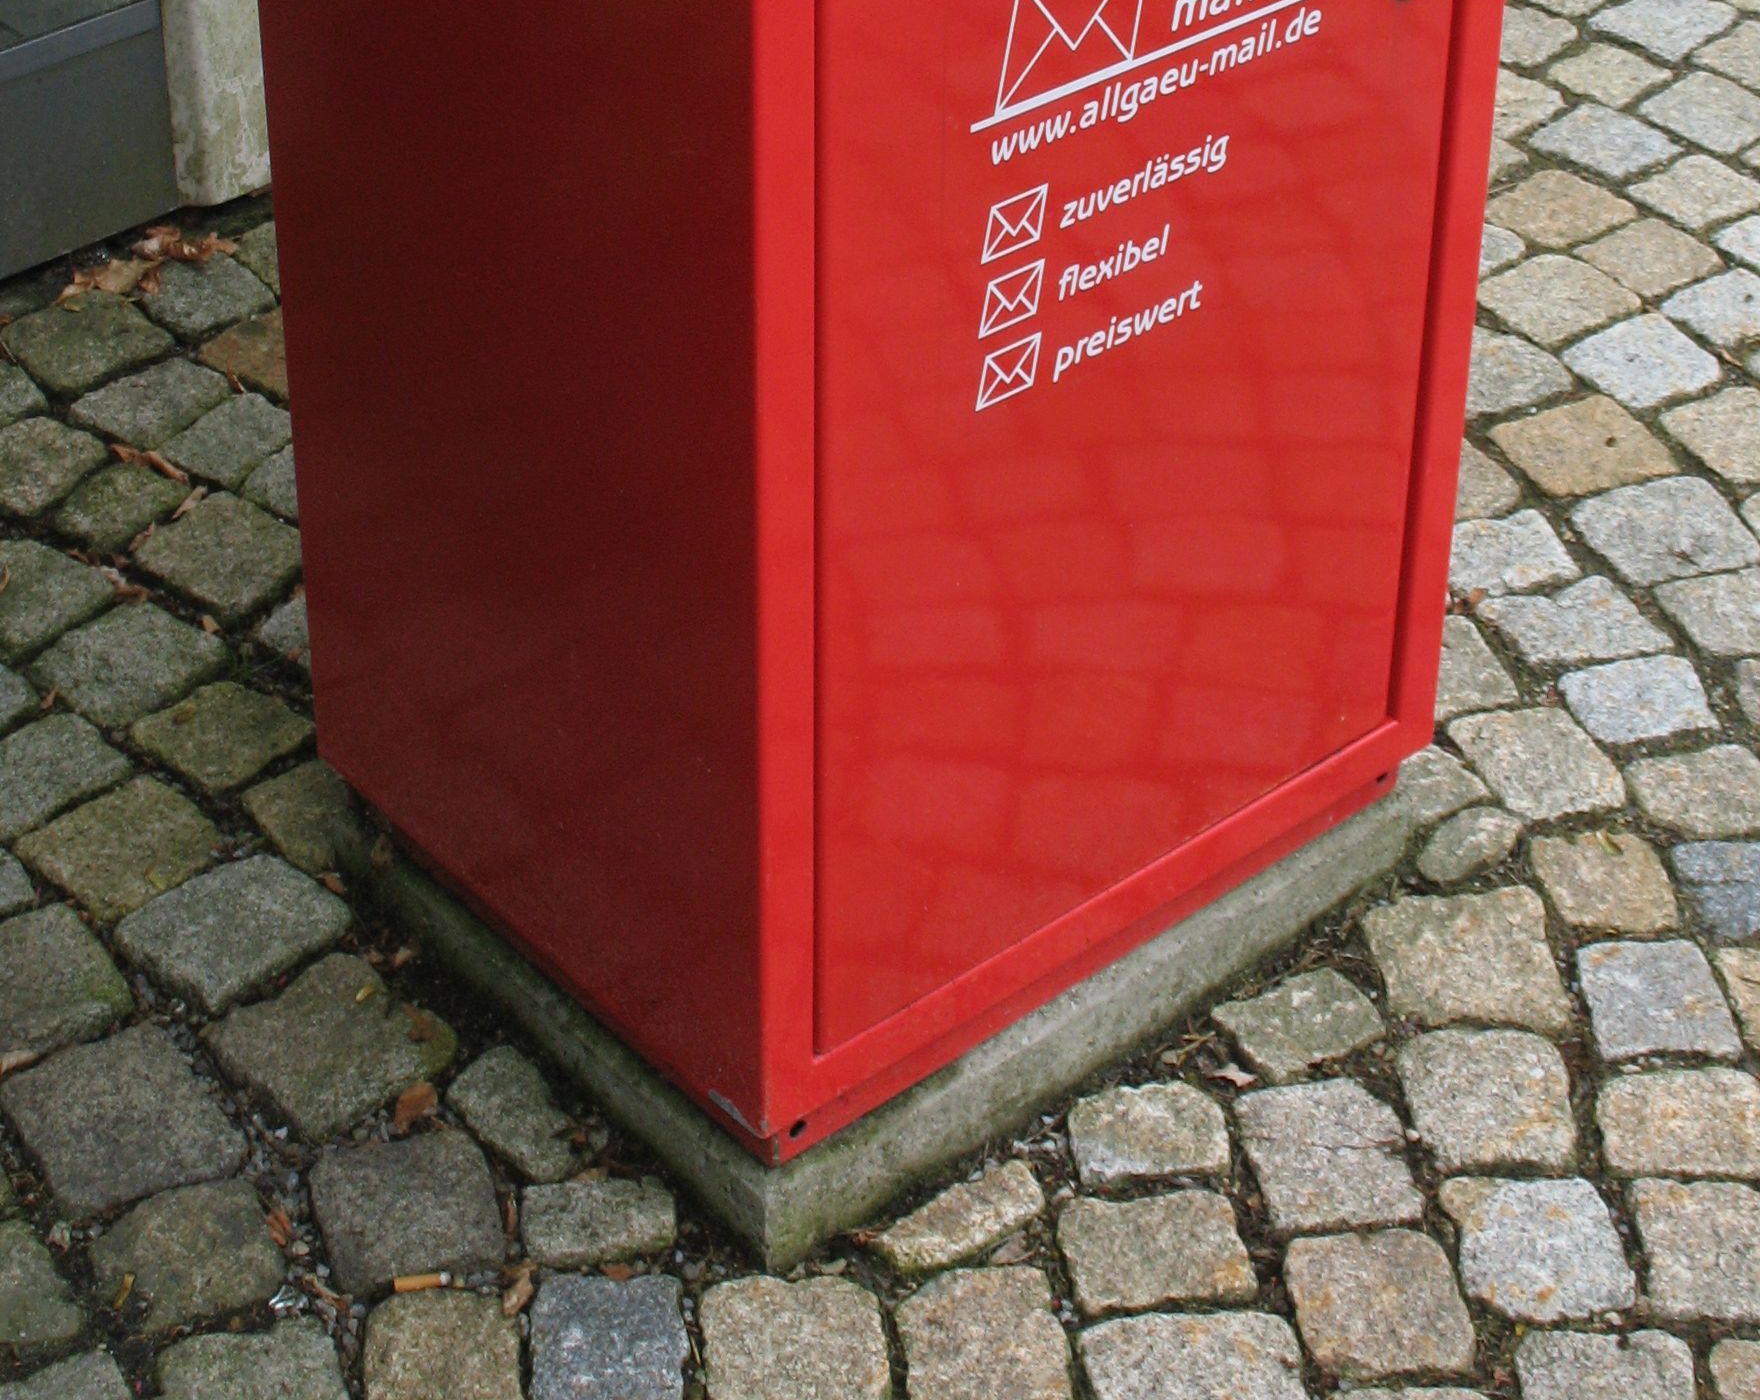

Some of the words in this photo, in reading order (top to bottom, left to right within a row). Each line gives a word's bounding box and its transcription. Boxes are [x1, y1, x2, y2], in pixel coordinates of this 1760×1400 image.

[989, 7, 1322, 166] www.allgaeu-mail.de
[1059, 133, 1230, 230] zuverlässig
[1057, 223, 1170, 302] flexibel
[1052, 279, 1203, 382] preiswert
